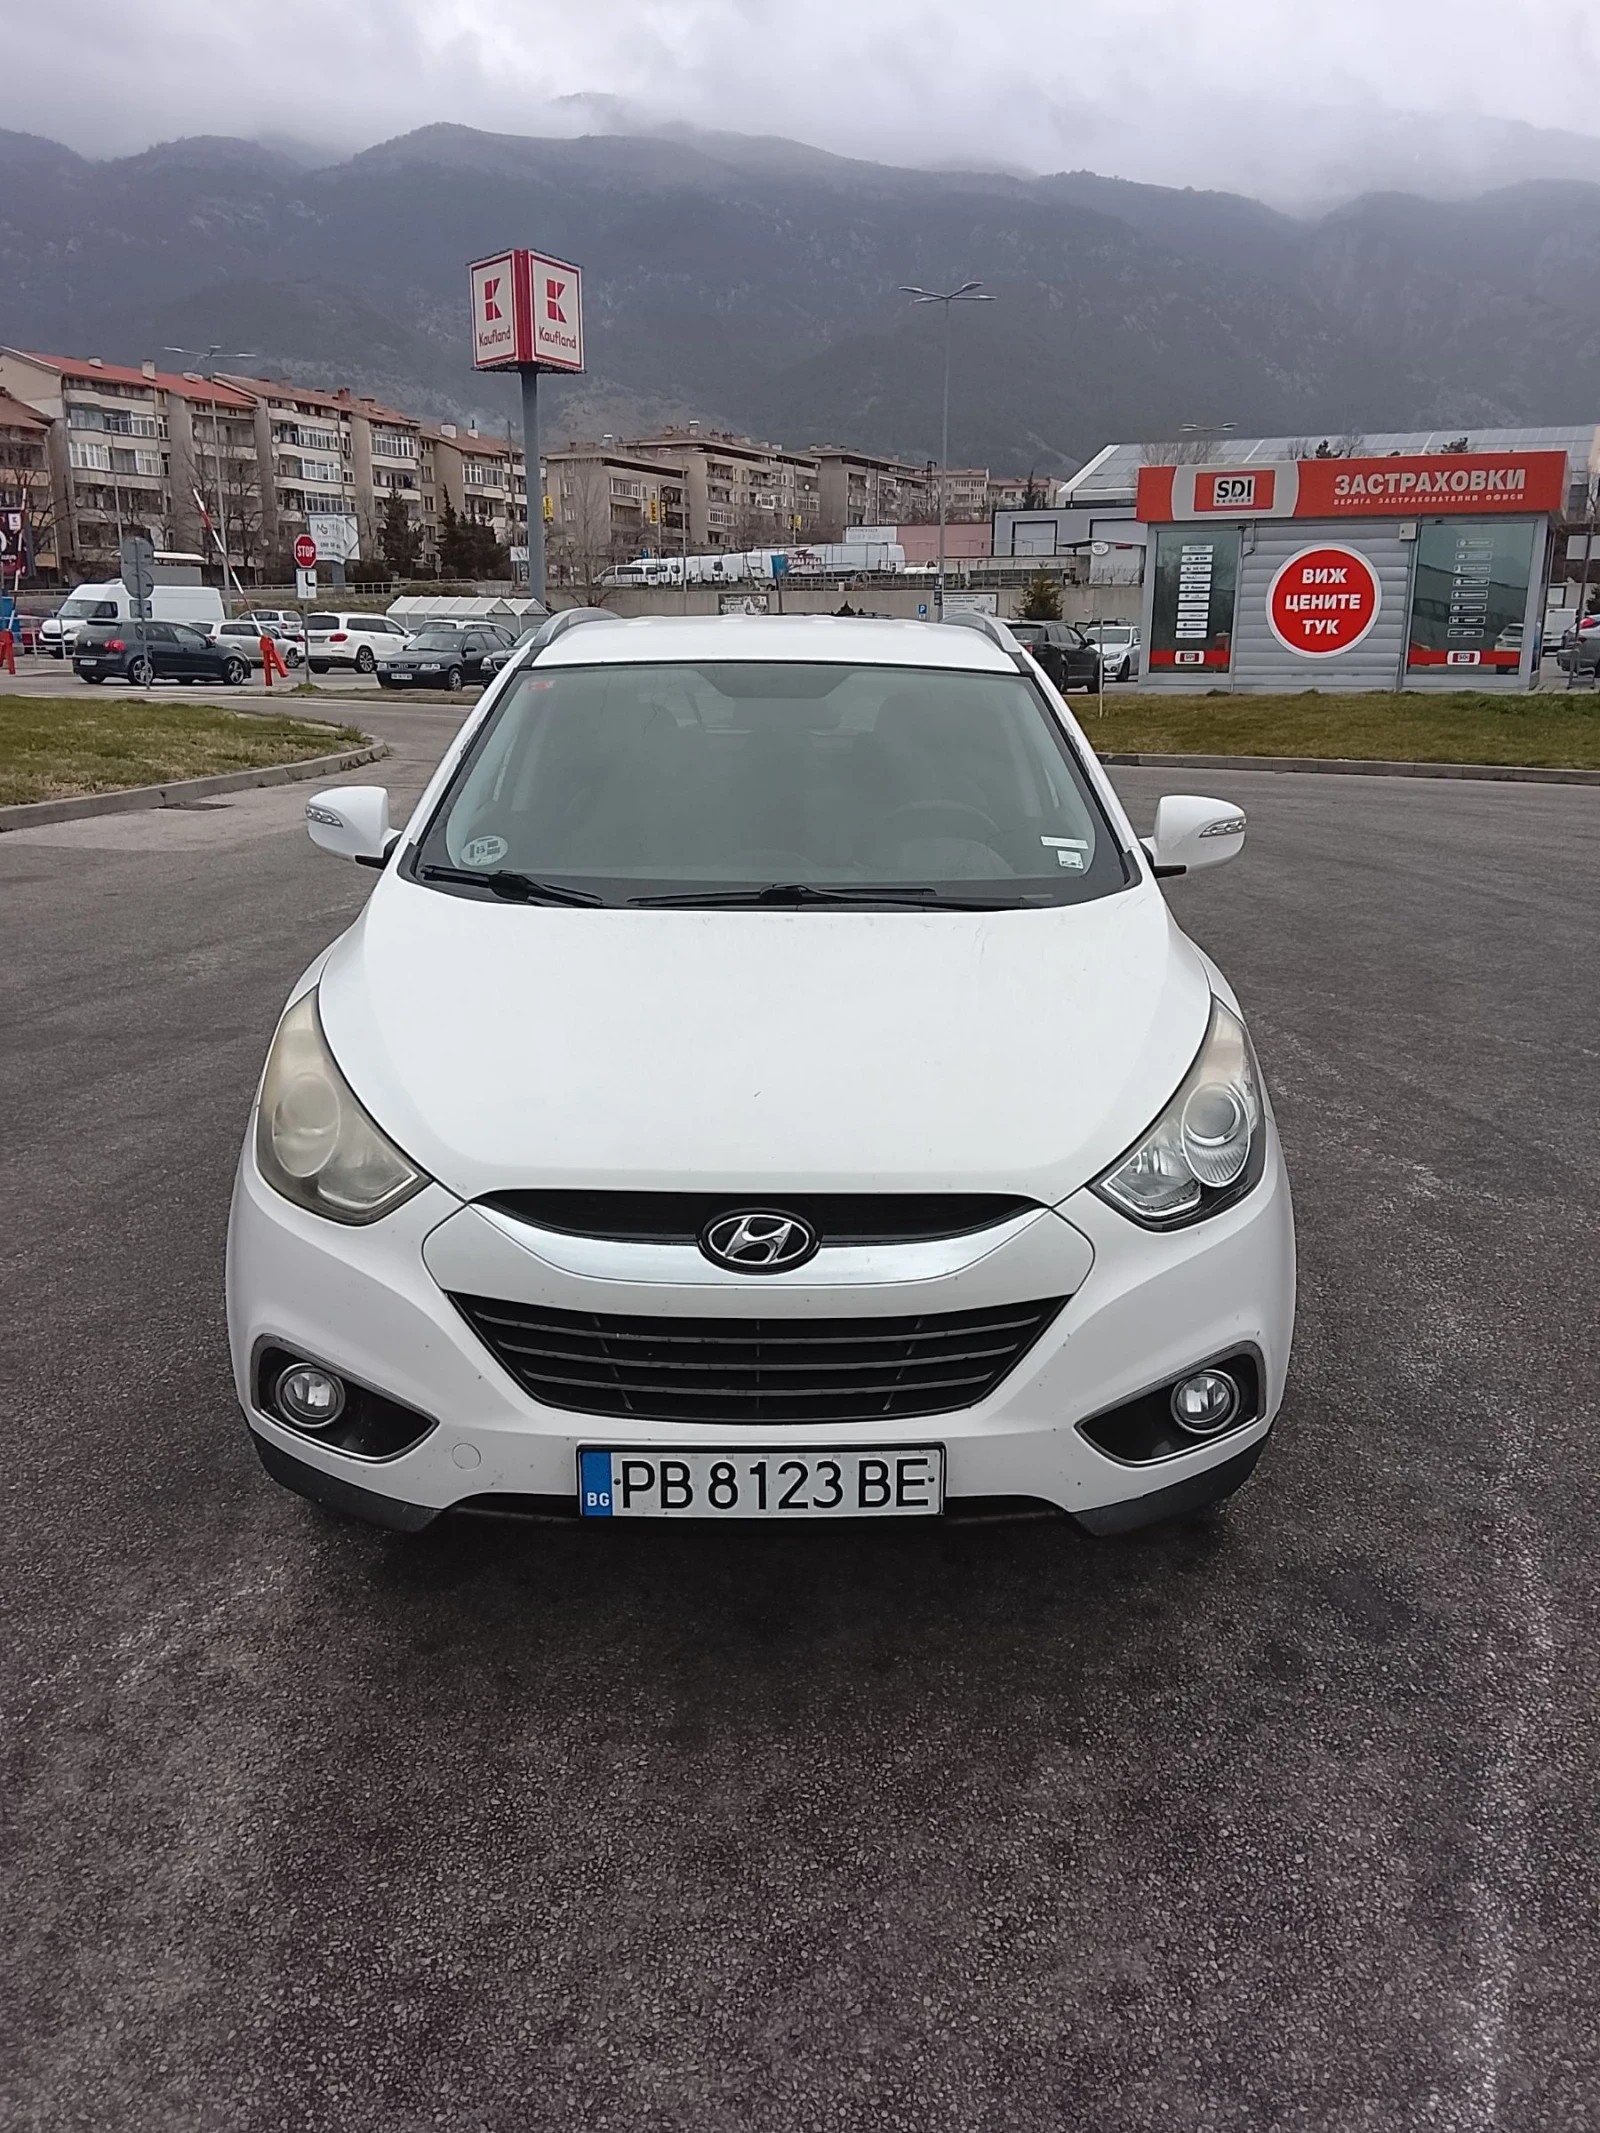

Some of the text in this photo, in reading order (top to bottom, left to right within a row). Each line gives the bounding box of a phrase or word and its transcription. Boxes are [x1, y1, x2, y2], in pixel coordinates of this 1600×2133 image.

[479, 325, 511, 347] Kaufland
[539, 326, 577, 349] Kaufland
[1216, 479, 1253, 498] SDI
[1334, 469, 1526, 496] ЗАСТРАХОВКИ
[1485, 493, 1524, 501] ОФИСИ
[297, 545, 315, 557] STOP
[1302, 568, 1348, 584] ВИЖ
[1285, 594, 1361, 613] ЦЕНИТЕ
[1302, 619, 1340, 635] ТУК
[621, 1457, 929, 1510] PB 8123 BE
[586, 1492, 610, 1507] BG
